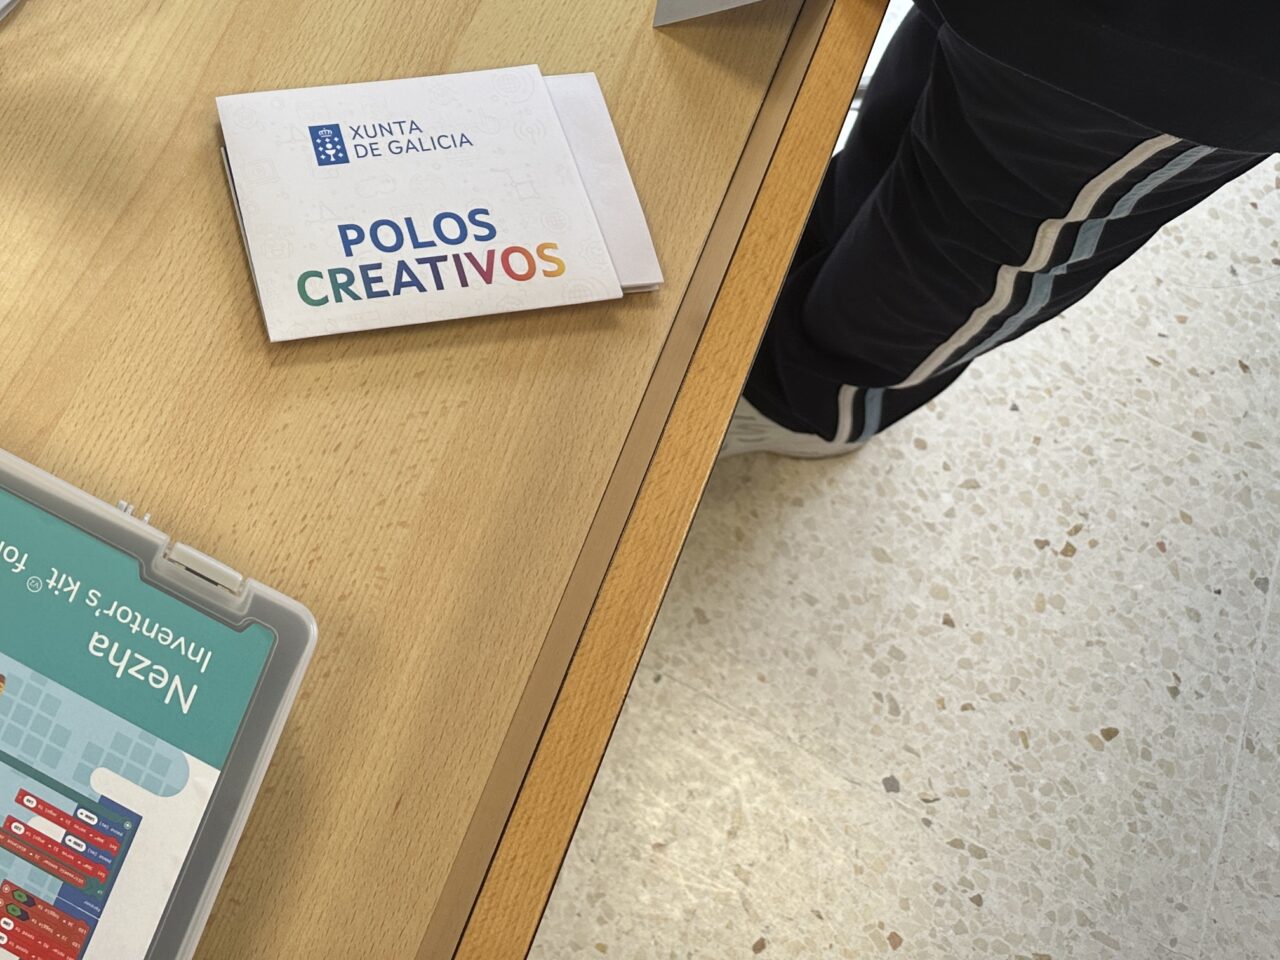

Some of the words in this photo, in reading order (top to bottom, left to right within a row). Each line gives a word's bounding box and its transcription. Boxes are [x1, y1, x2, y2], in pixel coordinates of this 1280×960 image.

[349, 120, 424, 141] XUNTA
[354, 141, 381, 159] DE
[387, 133, 474, 156] GALICIA
[337, 208, 497, 258] POLOS
[296, 242, 567, 307] CREATIVOS
[41, 566, 81, 603] kit
[84, 588, 212, 673] Inventor's
[87, 631, 198, 714] Nezha
